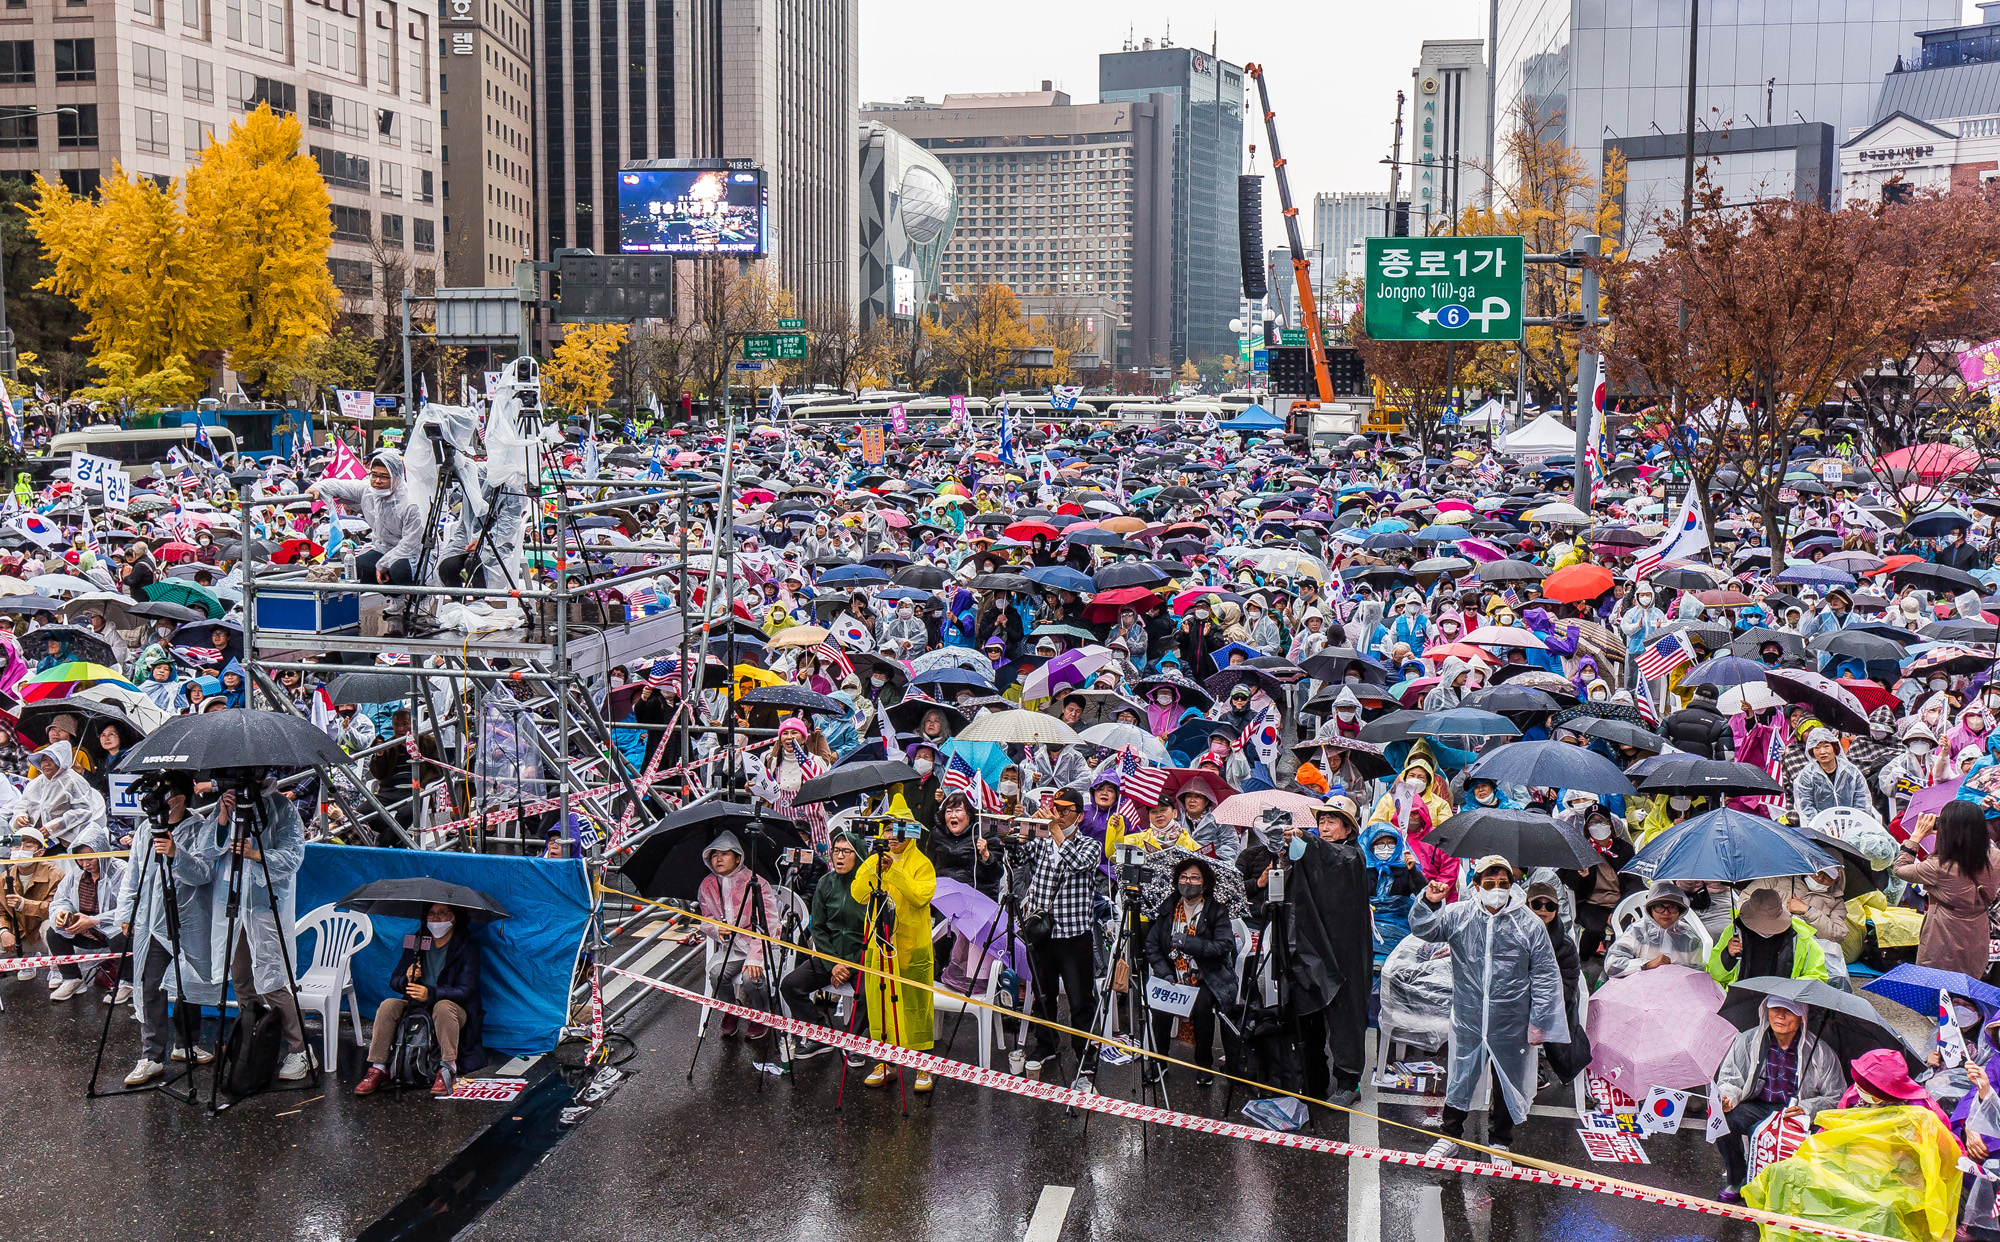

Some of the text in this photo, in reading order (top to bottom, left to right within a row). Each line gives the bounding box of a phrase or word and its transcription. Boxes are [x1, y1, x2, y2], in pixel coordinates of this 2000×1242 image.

[914, 112, 974, 121] PLAZA
[1858, 145, 1935, 162] 한국금융사박물관
[1378, 247, 1507, 278] 종로1가
[1377, 282, 1475, 303] Jongno 1(il)-ga
[1447, 308, 1460, 325] 6
[107, 475, 126, 503] 경산
[1151, 986, 1191, 1005] 생명수TV
[736, 1005, 762, 1021] 안전제일
[763, 1014, 789, 1028] DANGER!
[790, 1022, 804, 1034] 위험
[814, 1030, 843, 1045] 안전제일
[843, 1037, 871, 1053] DANGER!
[873, 1046, 888, 1057] 위험
[900, 1052, 930, 1068] 안전제일
[930, 1061, 960, 1076] DANGER!
[961, 1069, 978, 1079] 위험
[989, 1076, 1023, 1090] 안전제일
[1023, 1084, 1055, 1097] DANGER!
[1056, 1091, 1074, 1101] 위험
[1086, 1098, 1122, 1111] 안전제일
[1123, 1105, 1158, 1118] DANGER!
[1159, 1112, 1177, 1121] 위험
[1191, 1117, 1229, 1130] 안전제일
[1230, 1125, 1267, 1137] DANGER!
[1269, 1131, 1289, 1139] 위험
[1304, 1137, 1344, 1149] 안전제일
[1581, 1131, 1615, 1158] 이재명
[1779, 1117, 1806, 1162] 이재
